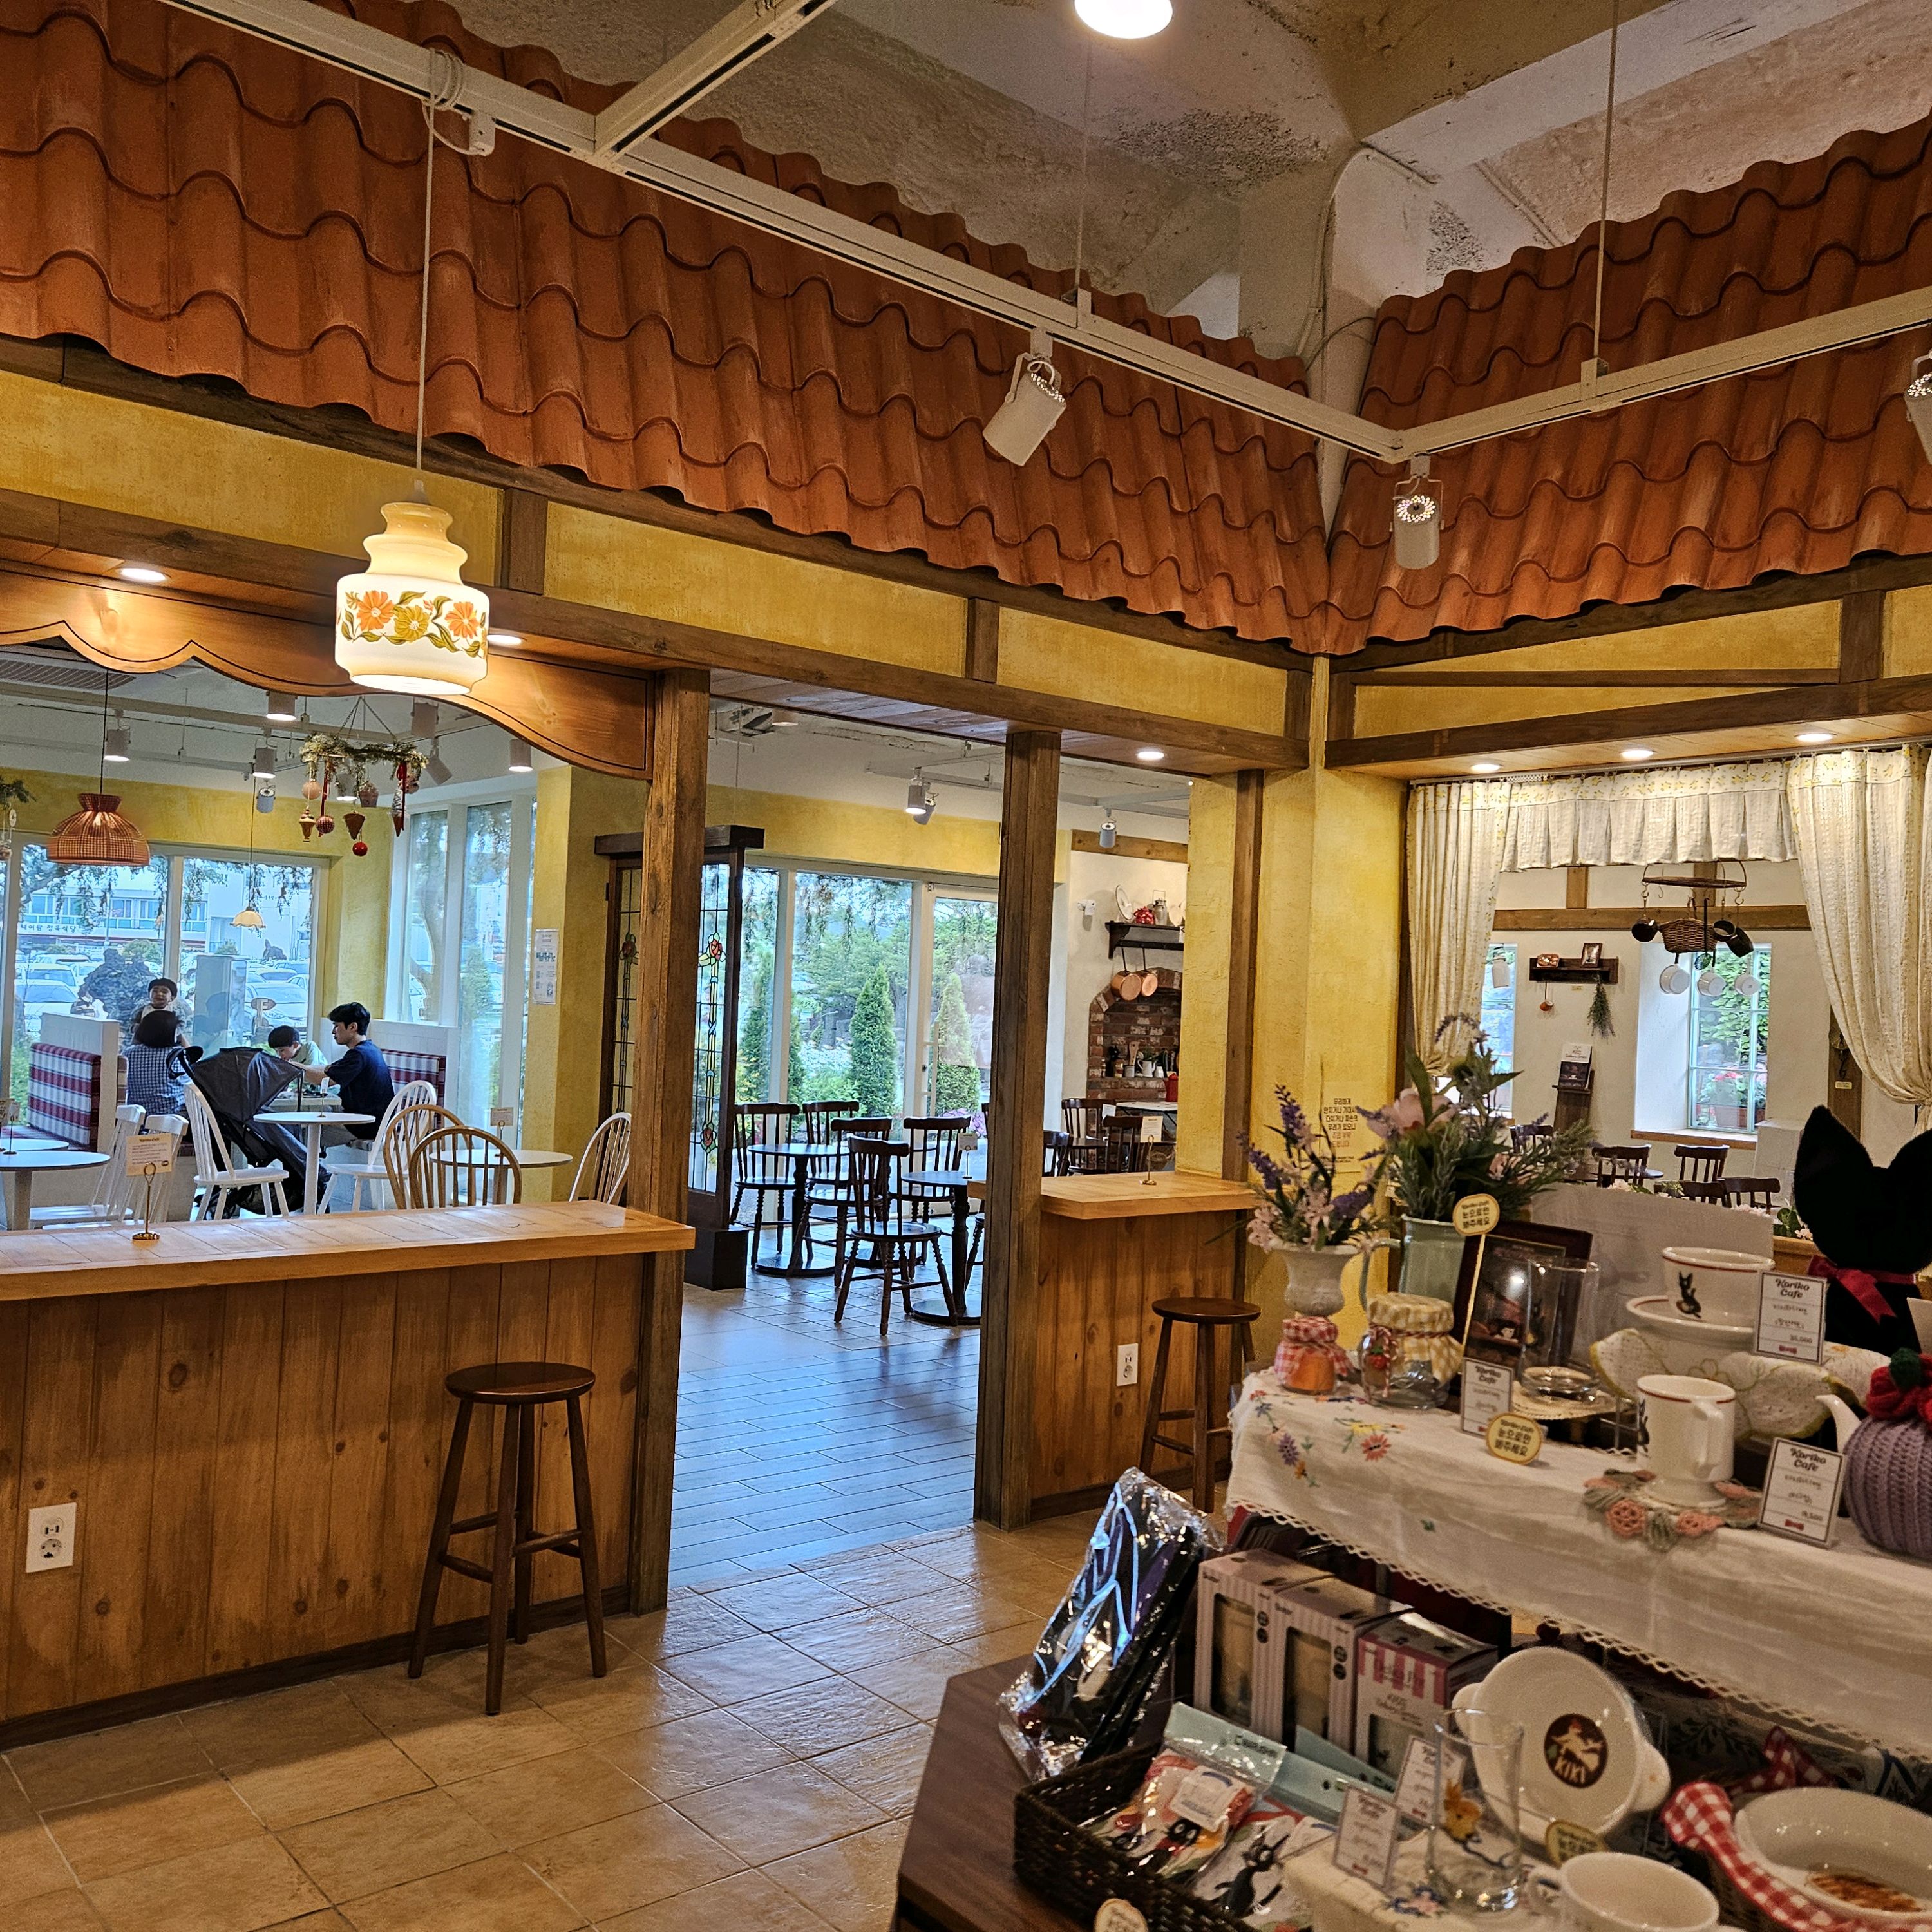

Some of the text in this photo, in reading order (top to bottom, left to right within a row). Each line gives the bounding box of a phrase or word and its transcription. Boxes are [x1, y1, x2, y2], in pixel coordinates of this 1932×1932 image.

[1776, 1278, 1810, 1291] Koriko
[1780, 1289, 1803, 1298] Cafe
[1497, 1427, 1531, 1444] 눈으로만
[1790, 1448, 1826, 1464] Koriko
[1794, 1459, 1819, 1472] Cafe
[1555, 1756, 1586, 1784] KIKI
